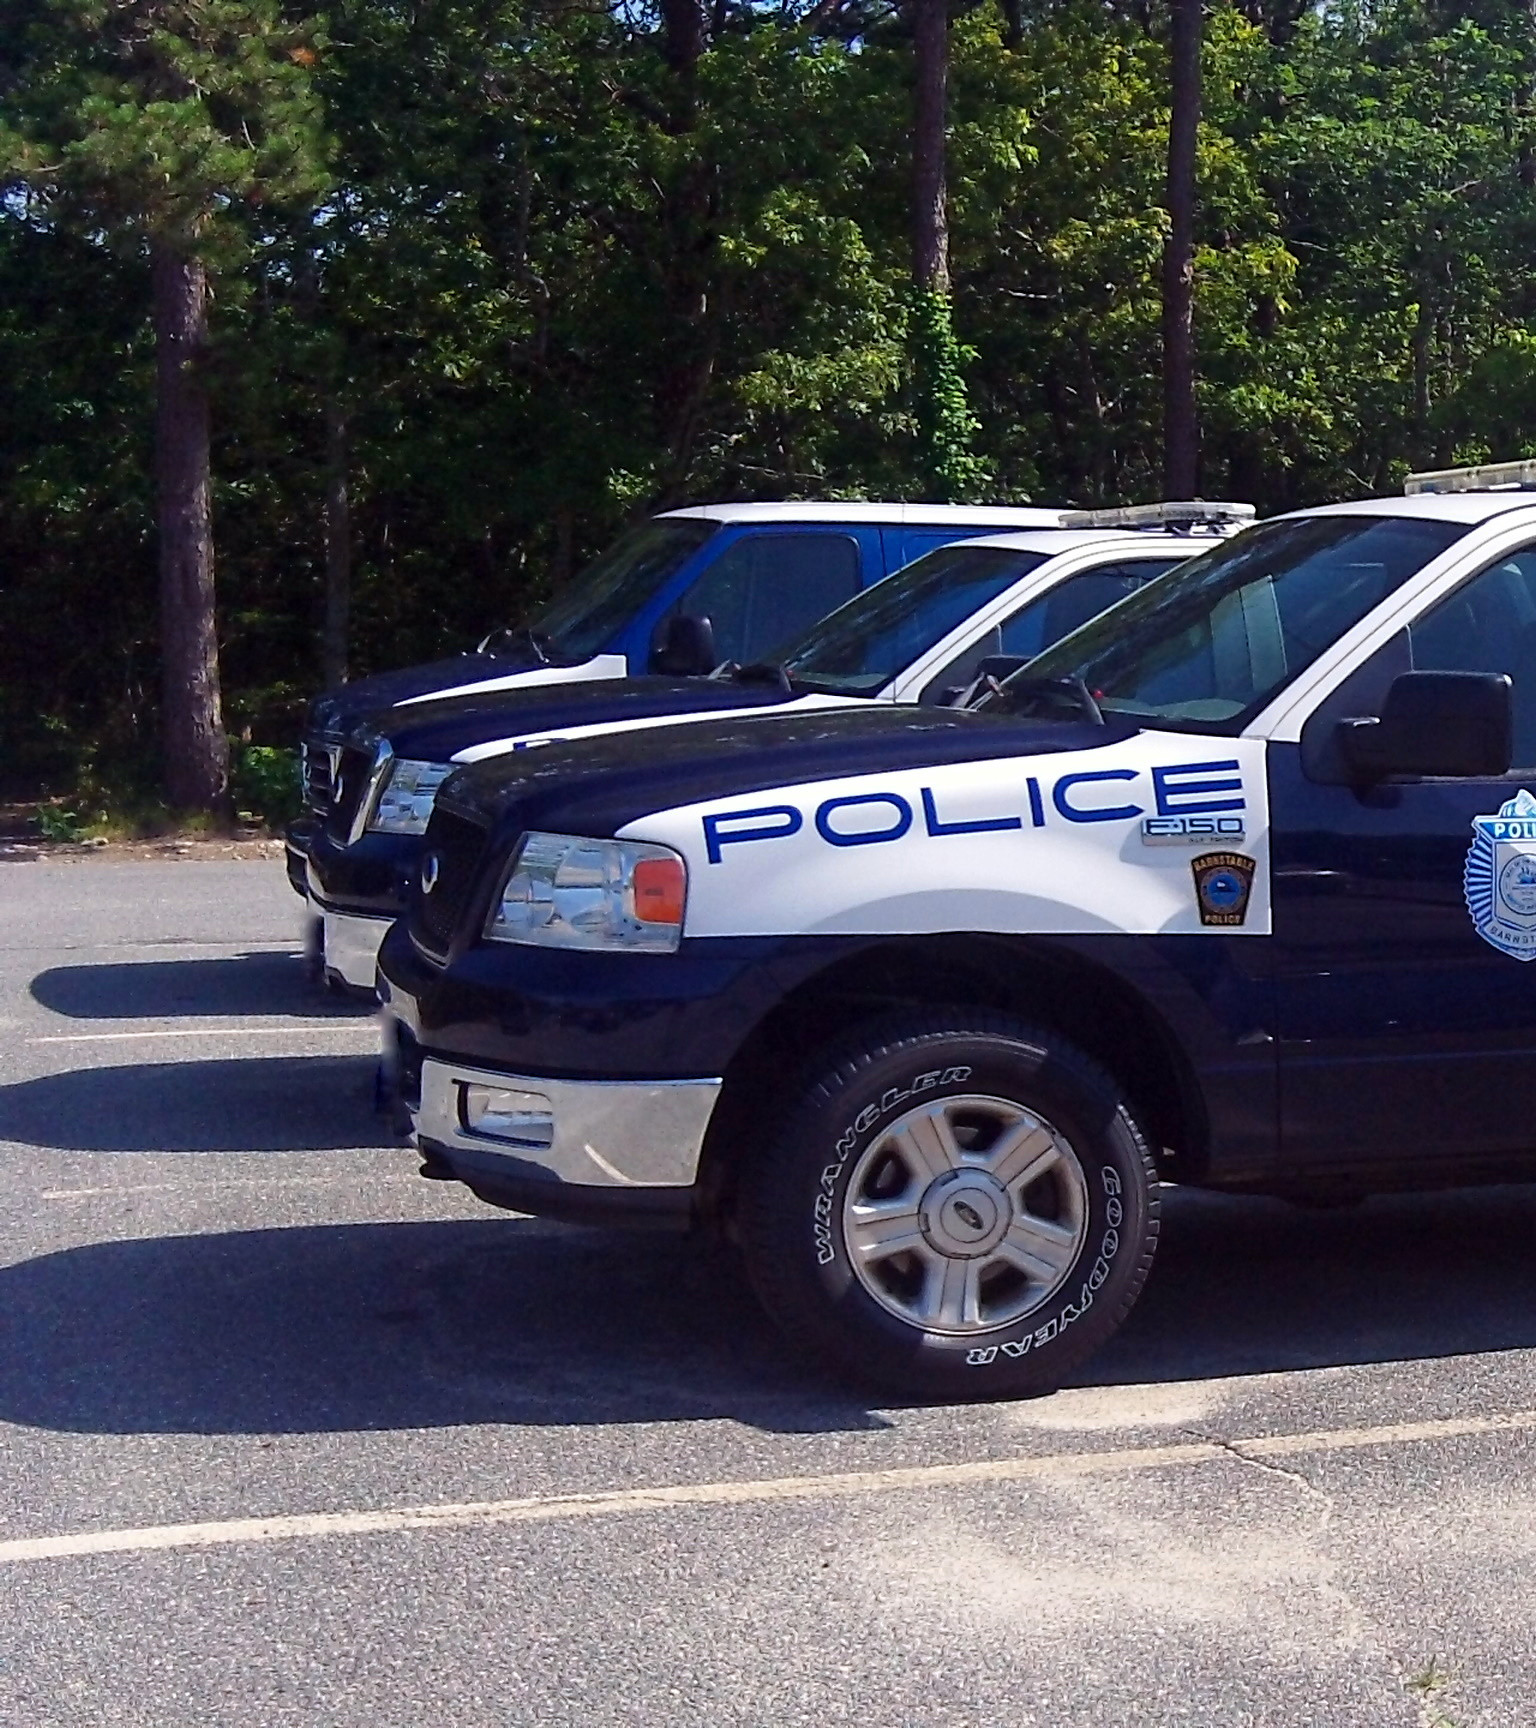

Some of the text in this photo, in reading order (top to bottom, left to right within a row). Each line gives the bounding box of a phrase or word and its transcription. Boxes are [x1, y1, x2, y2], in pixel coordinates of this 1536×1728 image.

[702, 759, 1246, 865] POLICE
[1204, 914, 1241, 924] POLICE
[811, 1066, 973, 1265] WRANGLER
[966, 1165, 1122, 1366] GOODYEAR
